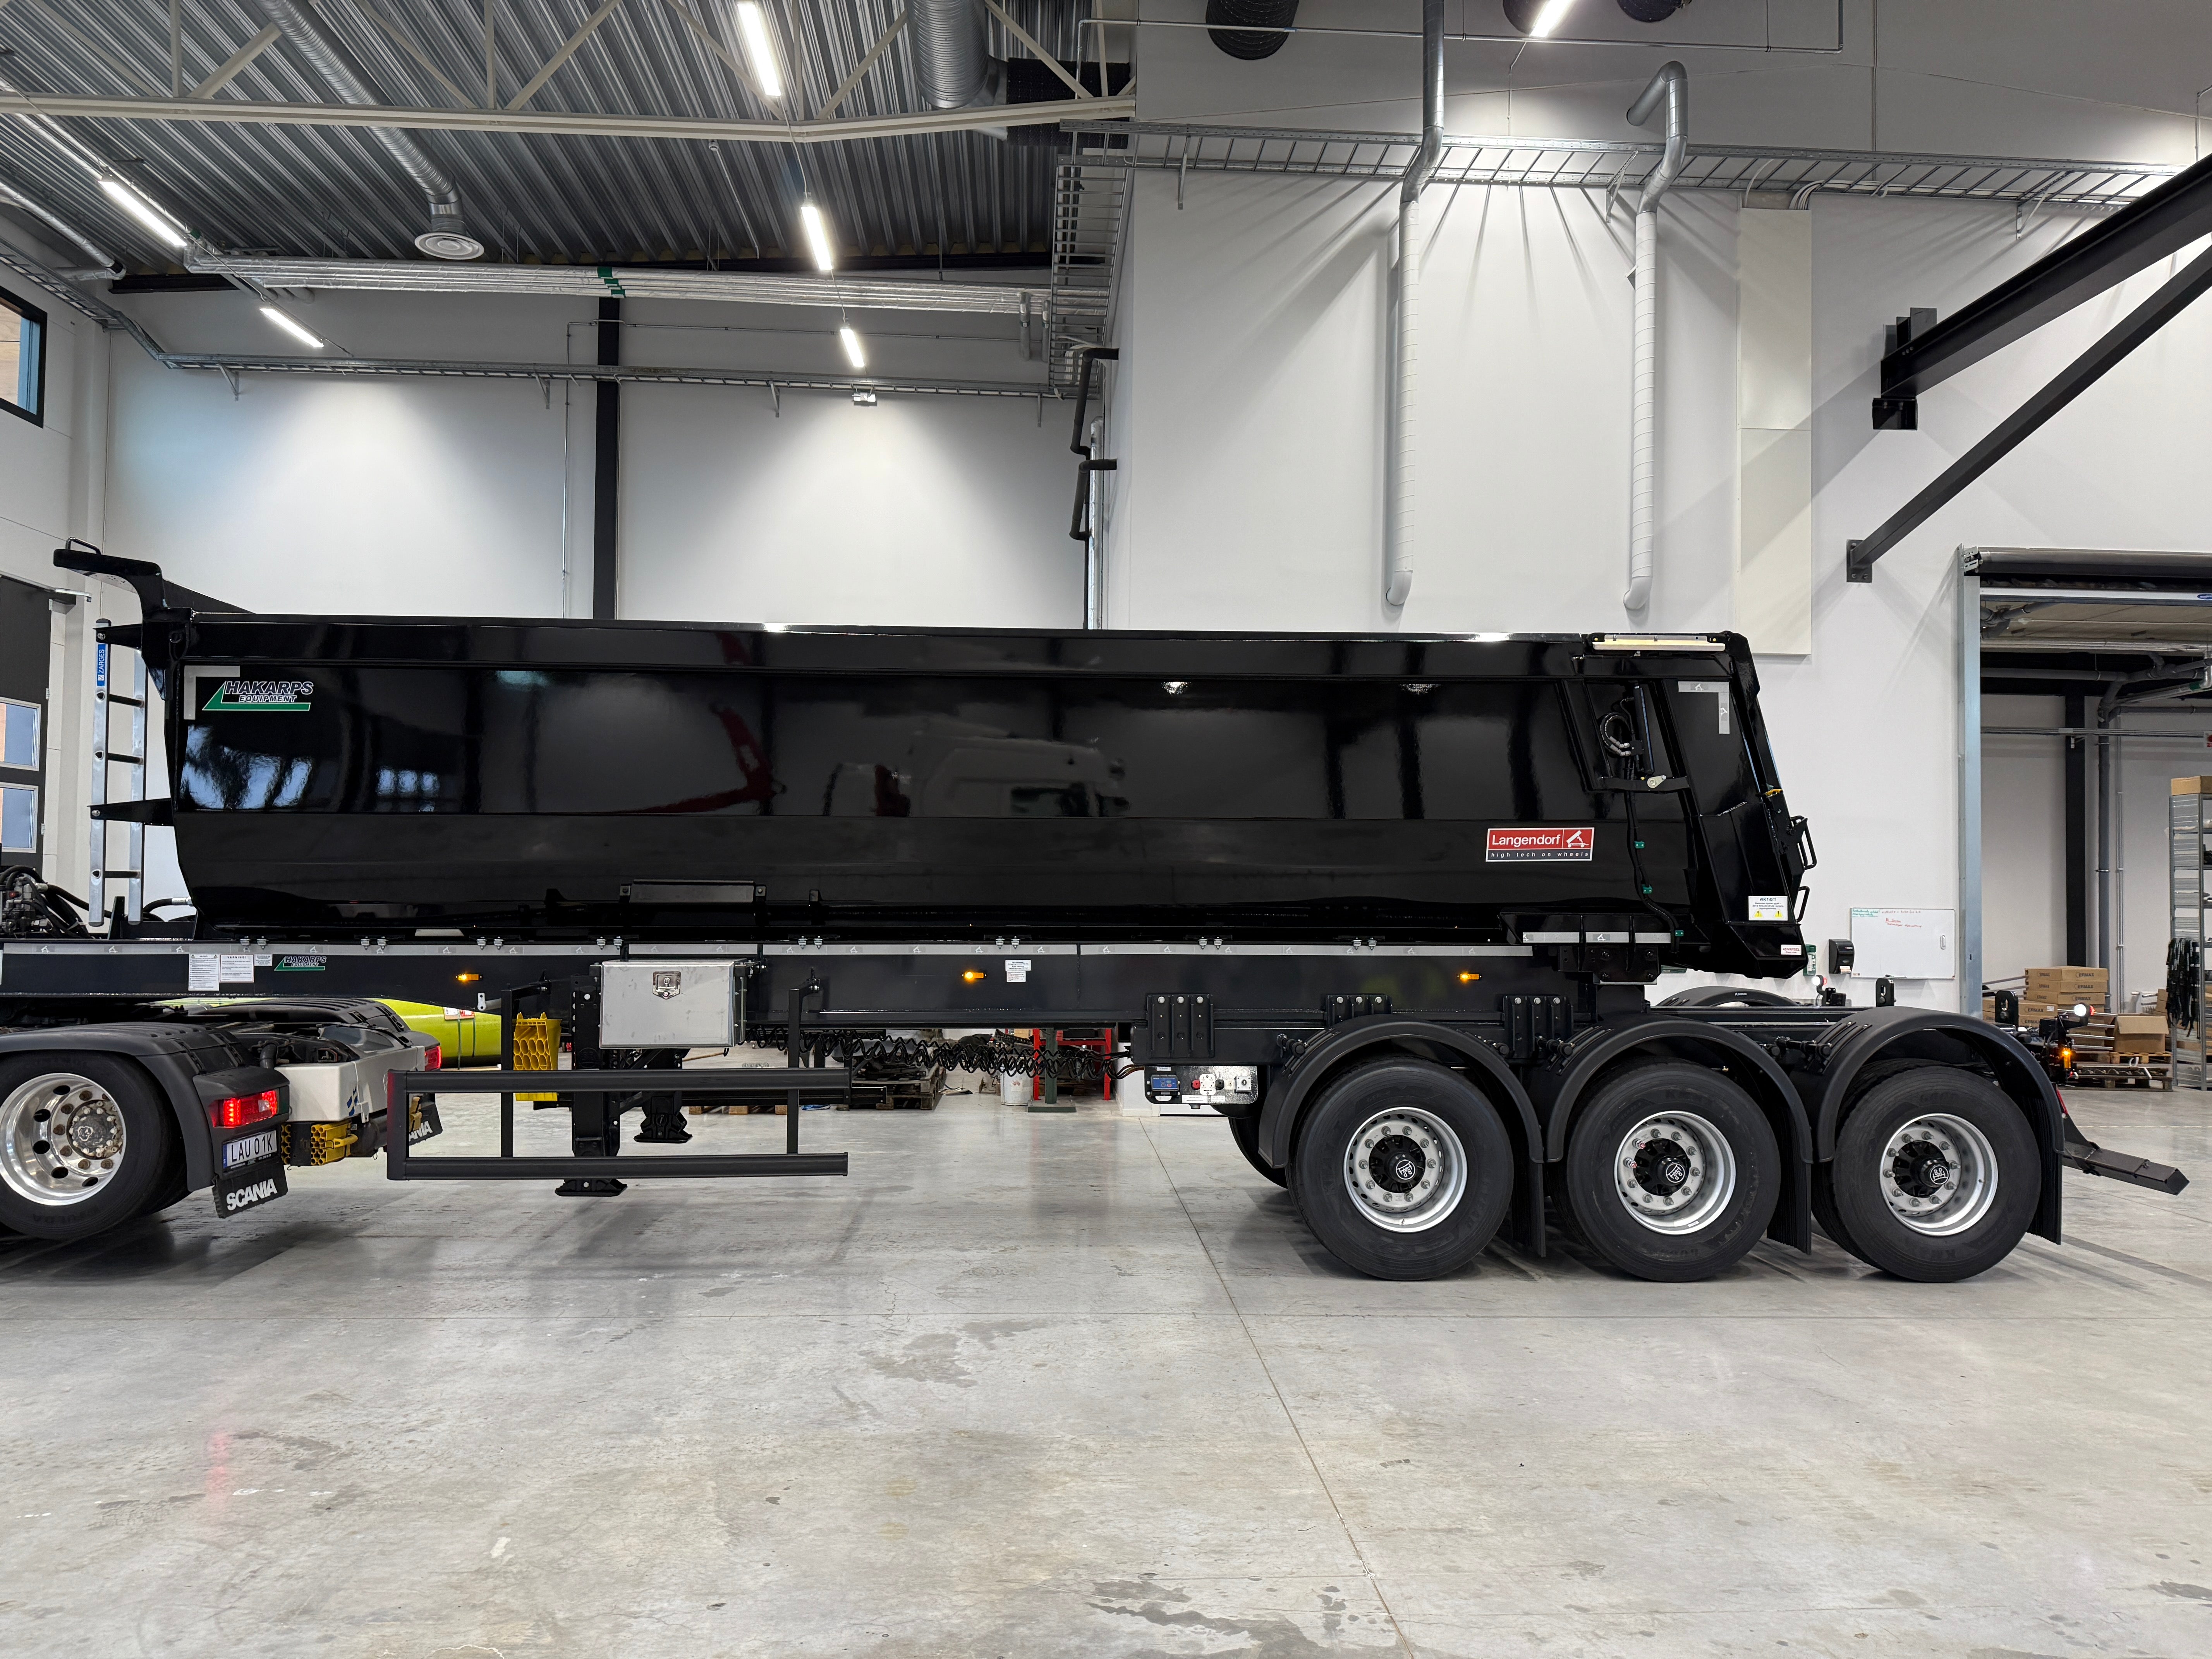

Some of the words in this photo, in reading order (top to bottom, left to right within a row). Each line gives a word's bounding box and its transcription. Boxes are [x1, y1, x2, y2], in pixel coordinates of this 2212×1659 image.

[225, 681, 314, 695] HAKARPS
[1492, 834, 1561, 847] Langendorf
[231, 1140, 251, 1162] LAU
[226, 1178, 278, 1211] SCANIA
